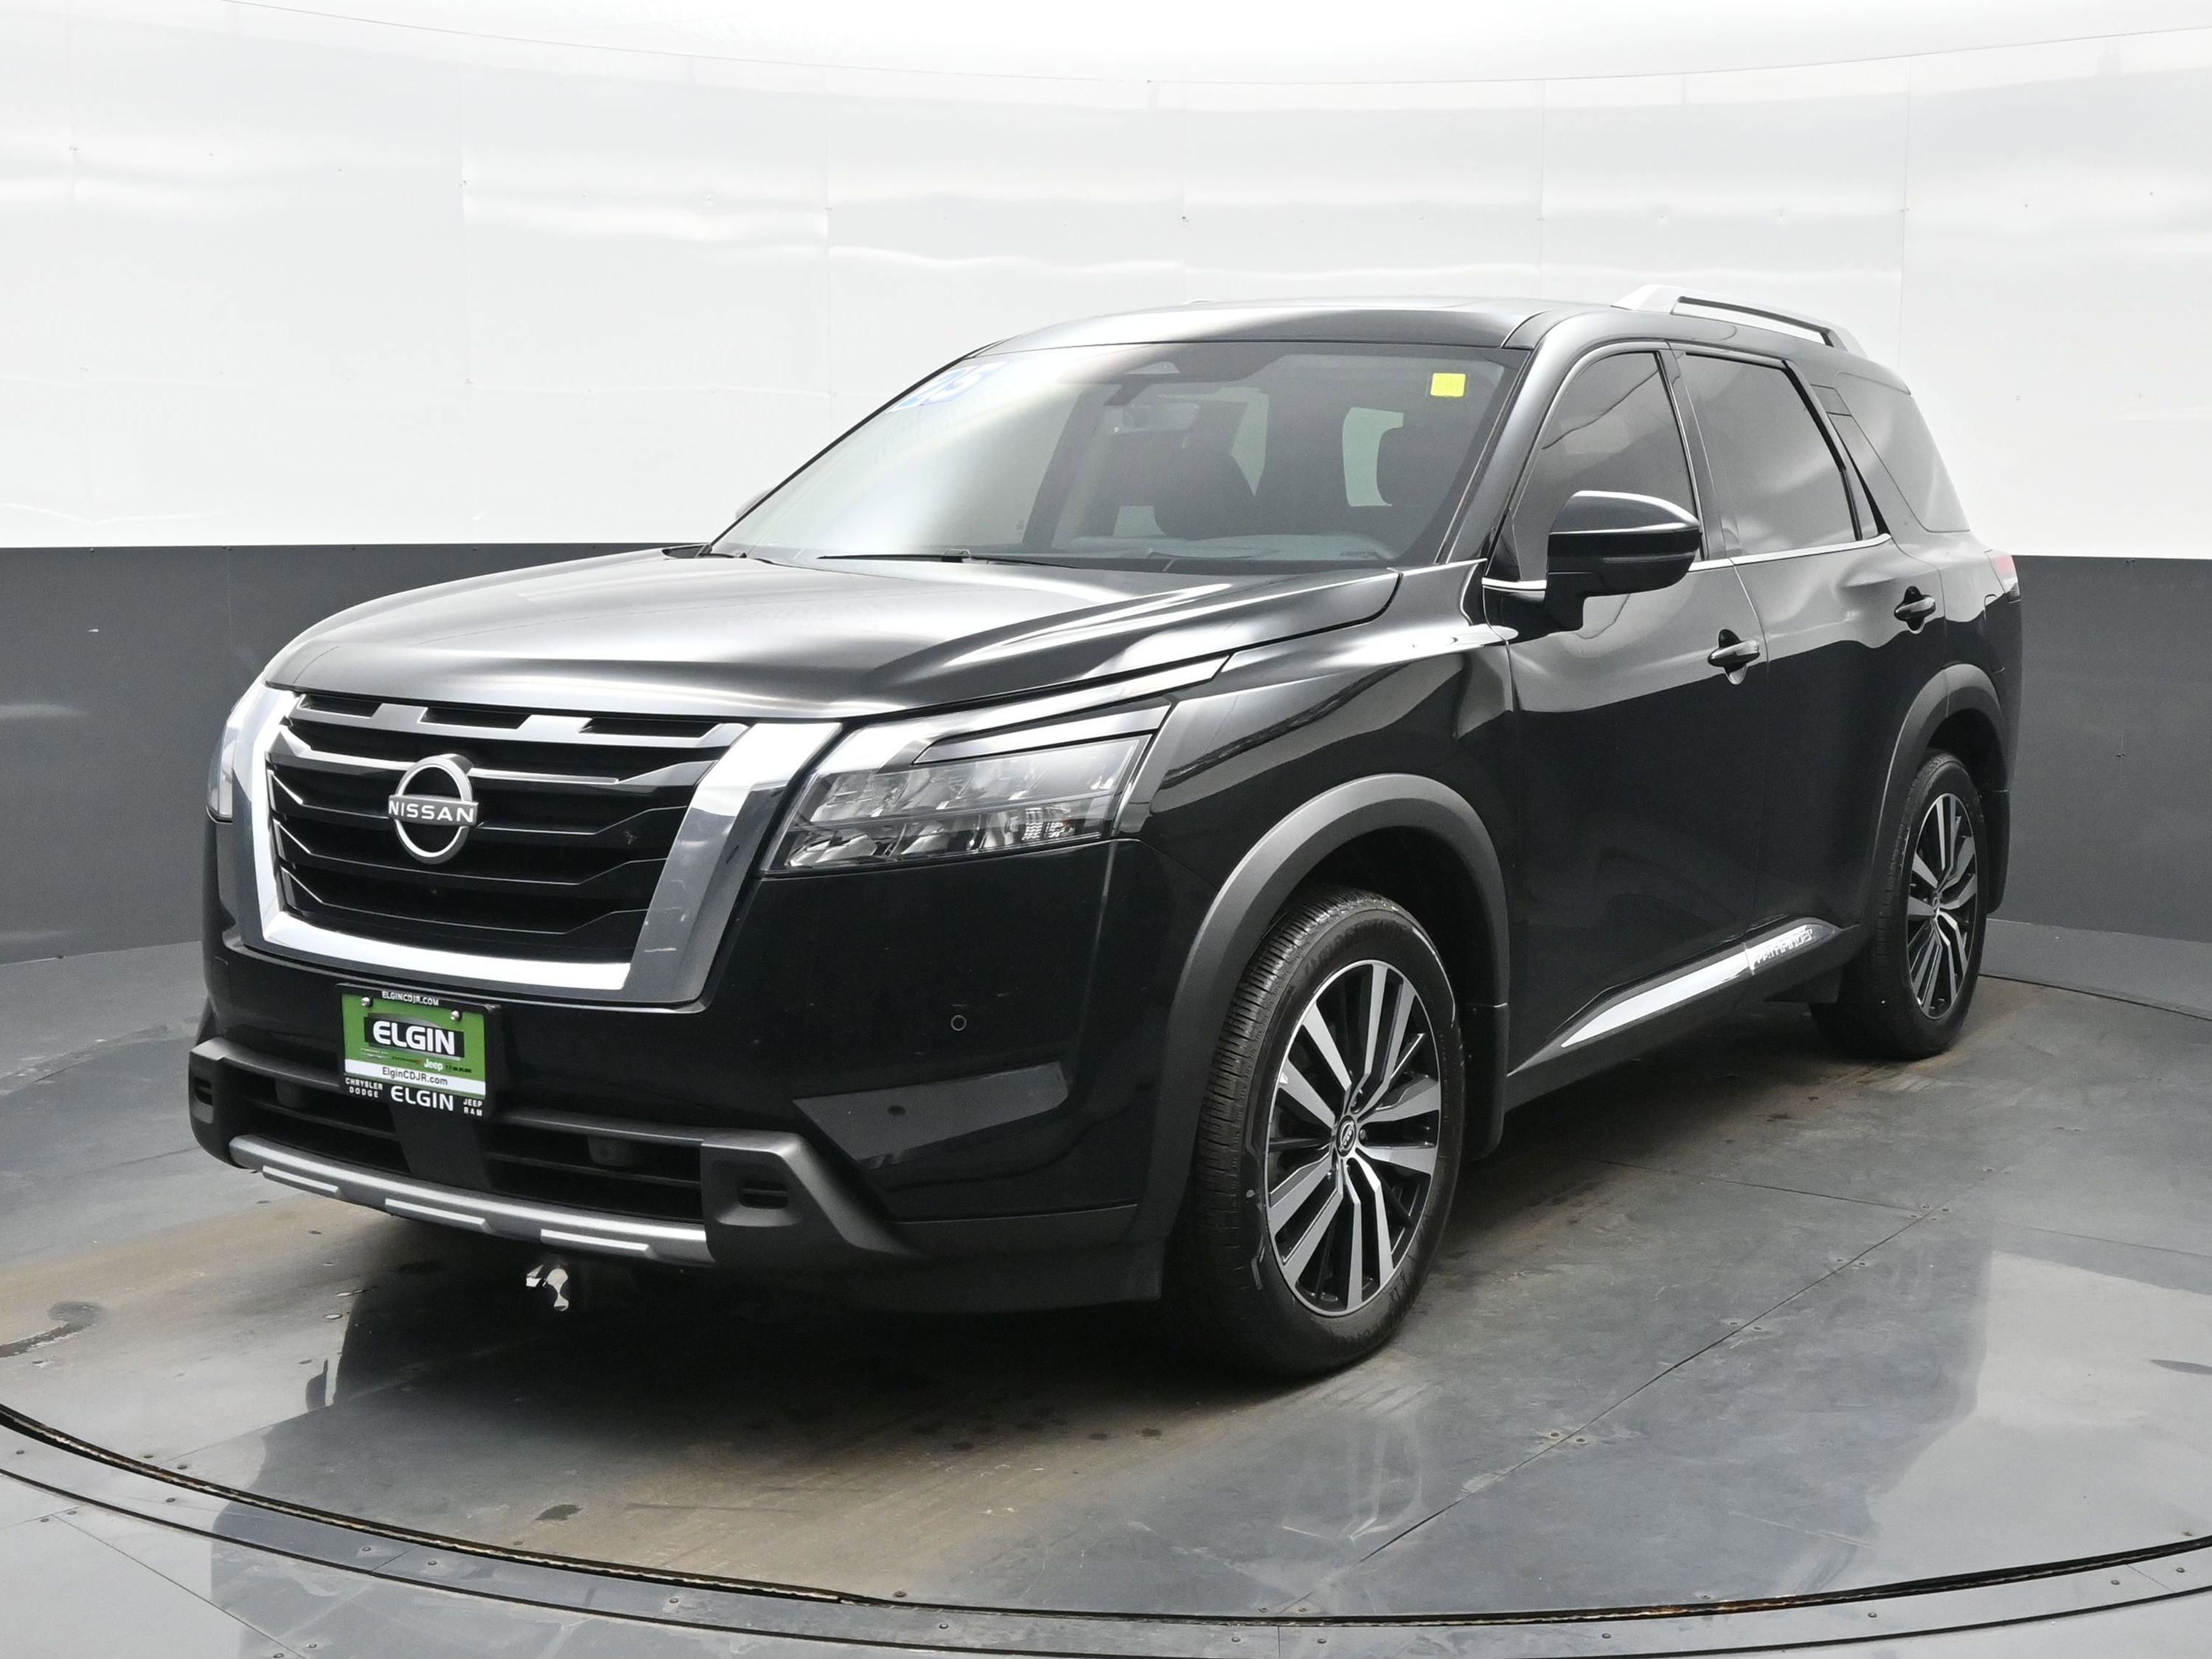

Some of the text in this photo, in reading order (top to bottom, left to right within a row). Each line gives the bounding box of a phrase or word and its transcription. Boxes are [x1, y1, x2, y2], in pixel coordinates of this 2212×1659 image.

[389, 800, 474, 823] NISSAN
[381, 991, 439, 1006] ELGINCDJR.COM
[372, 1020, 455, 1055] ELGIN
[423, 1058, 444, 1071] Jeep
[382, 1067, 448, 1086] ElginCDJR.com
[345, 1077, 383, 1091] CHRYSLER
[349, 1086, 379, 1098] DODGE
[391, 1085, 454, 1112] ELGIN
[463, 1098, 483, 1107] JEEP
[463, 1107, 483, 1116] RAM
